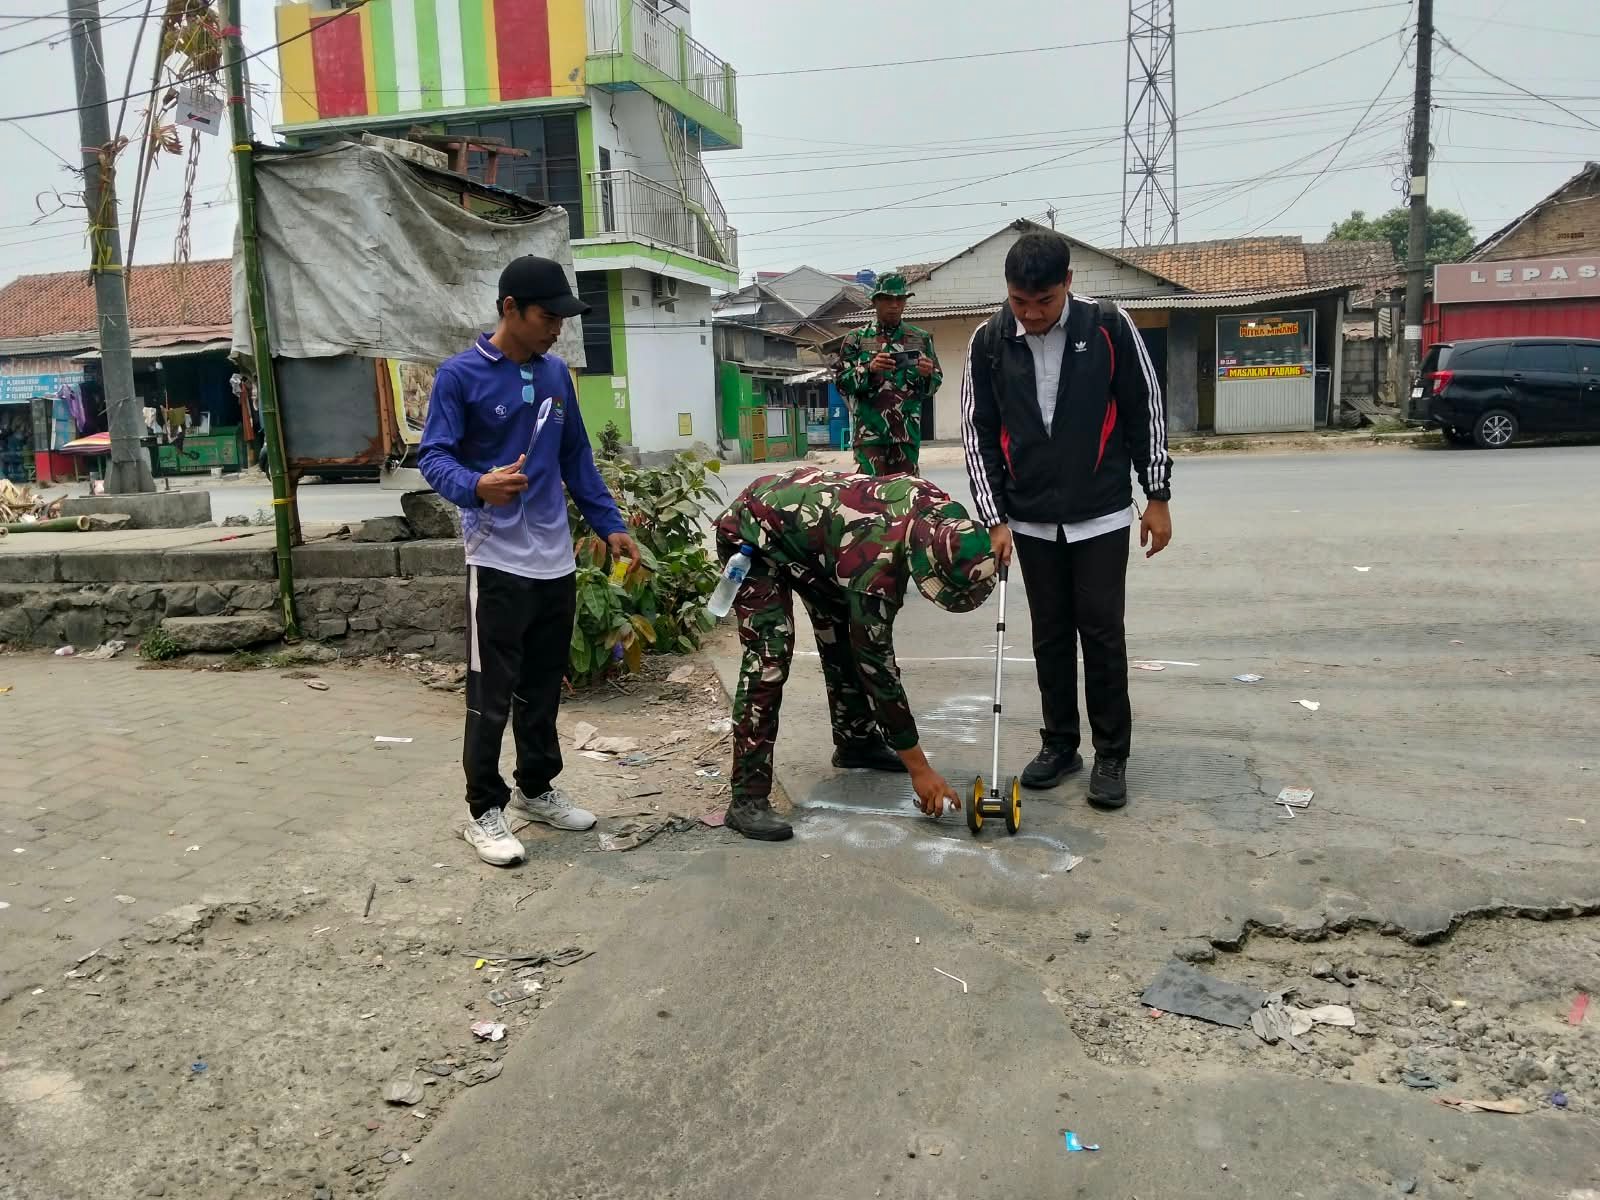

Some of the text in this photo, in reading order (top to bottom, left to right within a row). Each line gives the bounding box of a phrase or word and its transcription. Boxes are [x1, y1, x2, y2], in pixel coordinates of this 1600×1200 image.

[1267, 324, 1298, 335] MINANG
[1229, 366, 1301, 377] MASAKAN PADANG
